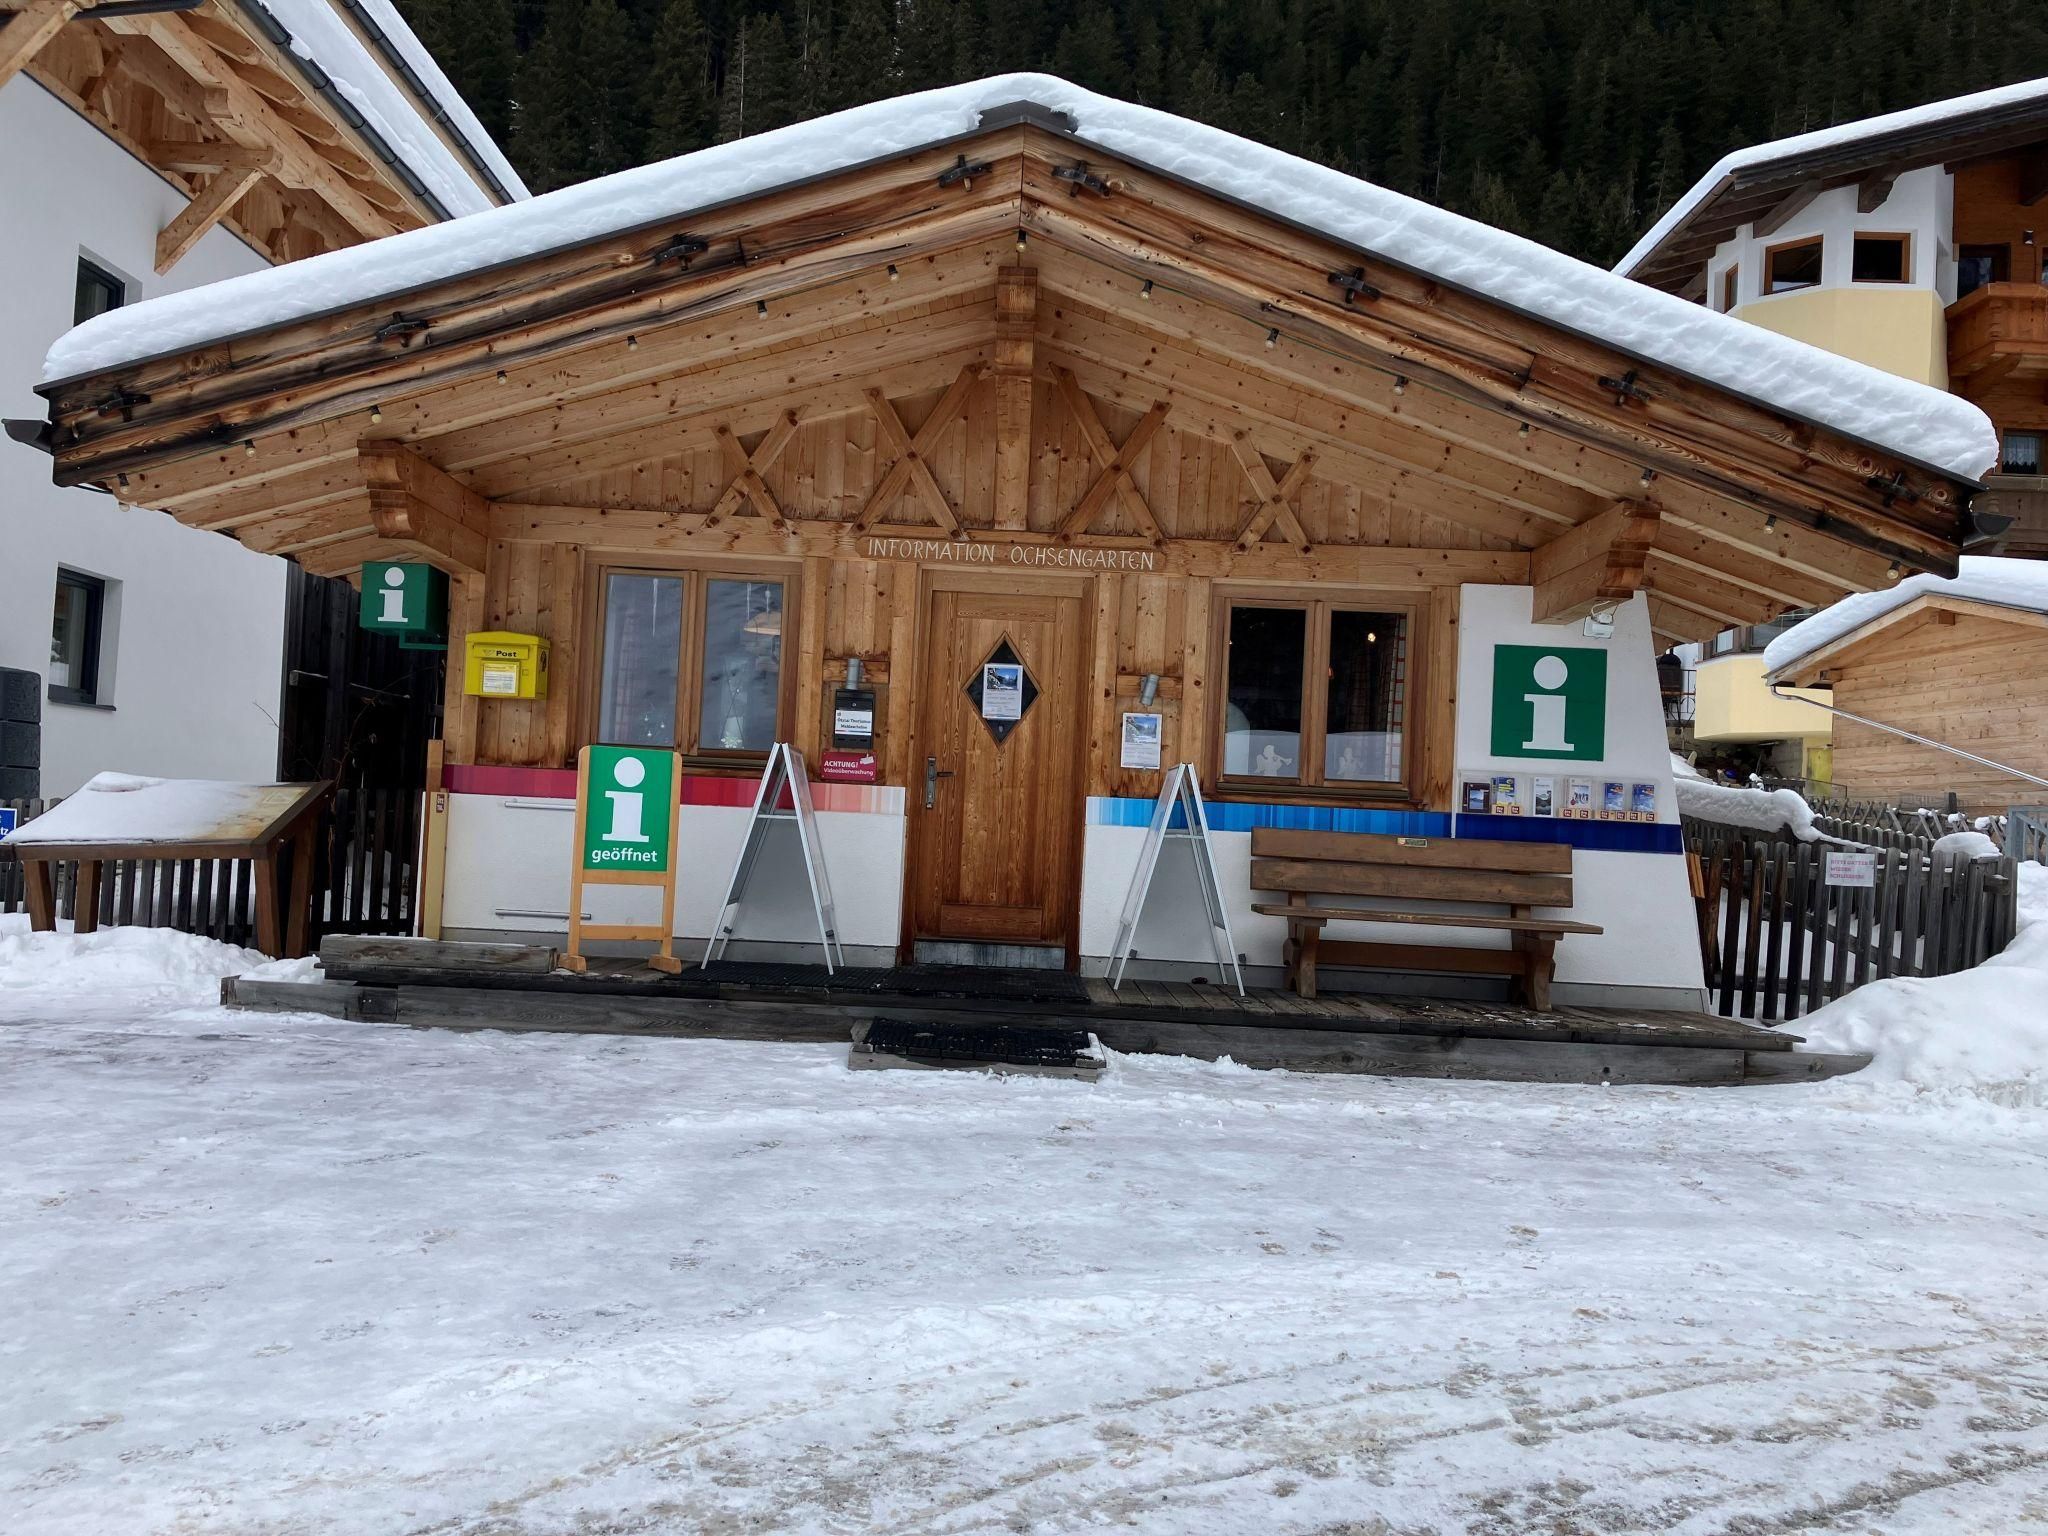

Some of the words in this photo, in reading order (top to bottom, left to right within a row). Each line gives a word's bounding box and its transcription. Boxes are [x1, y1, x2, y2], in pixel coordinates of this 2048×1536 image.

[868, 538, 995, 562] INFORMATION
[1010, 545, 1154, 571] OCHSENGARTEN
[824, 760, 859, 768] ACHTUNG!
[823, 767, 874, 776] Videoüberwachung
[591, 847, 658, 863] geöffnet
